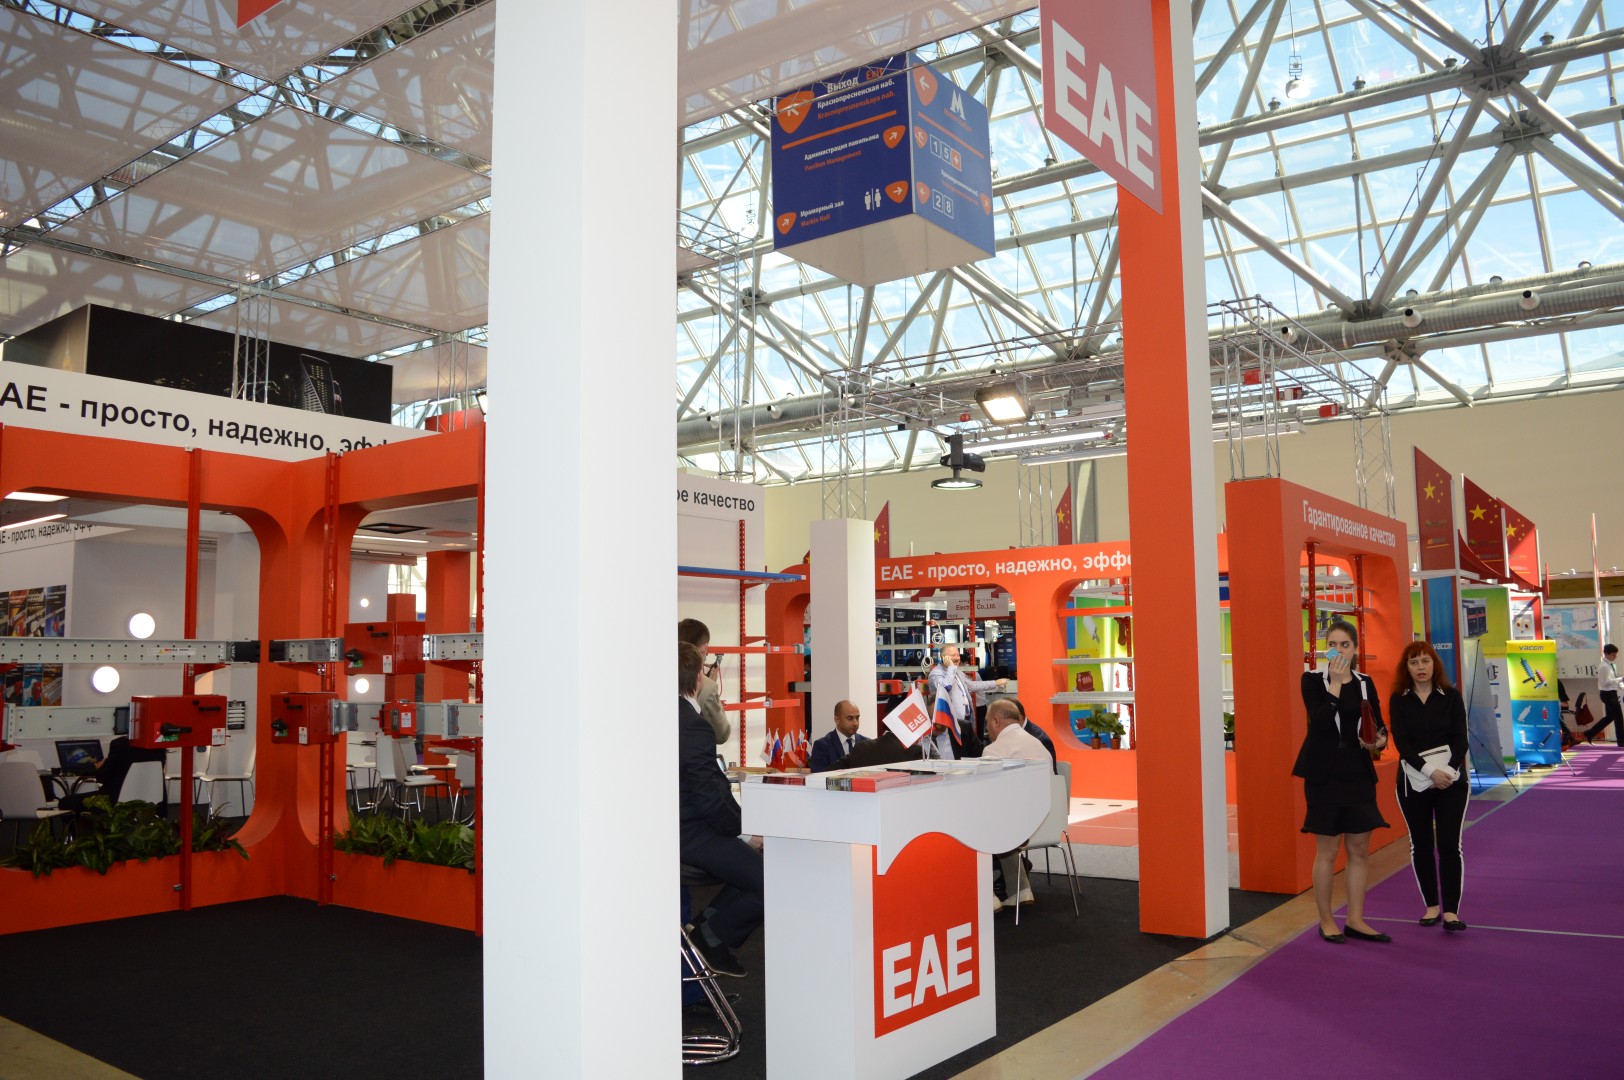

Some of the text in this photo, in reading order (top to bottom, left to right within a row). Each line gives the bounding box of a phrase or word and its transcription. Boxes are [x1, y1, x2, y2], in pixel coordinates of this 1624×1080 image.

[817, 79, 895, 109] Краснопресненская наб.
[827, 76, 859, 93] Выход
[1052, 19, 1154, 191] EAE
[81, 399, 197, 438] просто,
[693, 491, 755, 511] качество
[12, 528, 37, 544] просто,
[38, 522, 72, 539] надежно,
[1303, 499, 1396, 547] Гарантированное качество
[881, 564, 913, 581] EAE
[928, 562, 990, 581] просто,
[996, 557, 1077, 575] надежно,
[907, 713, 926, 730] EAE
[883, 924, 971, 1018] EAE
